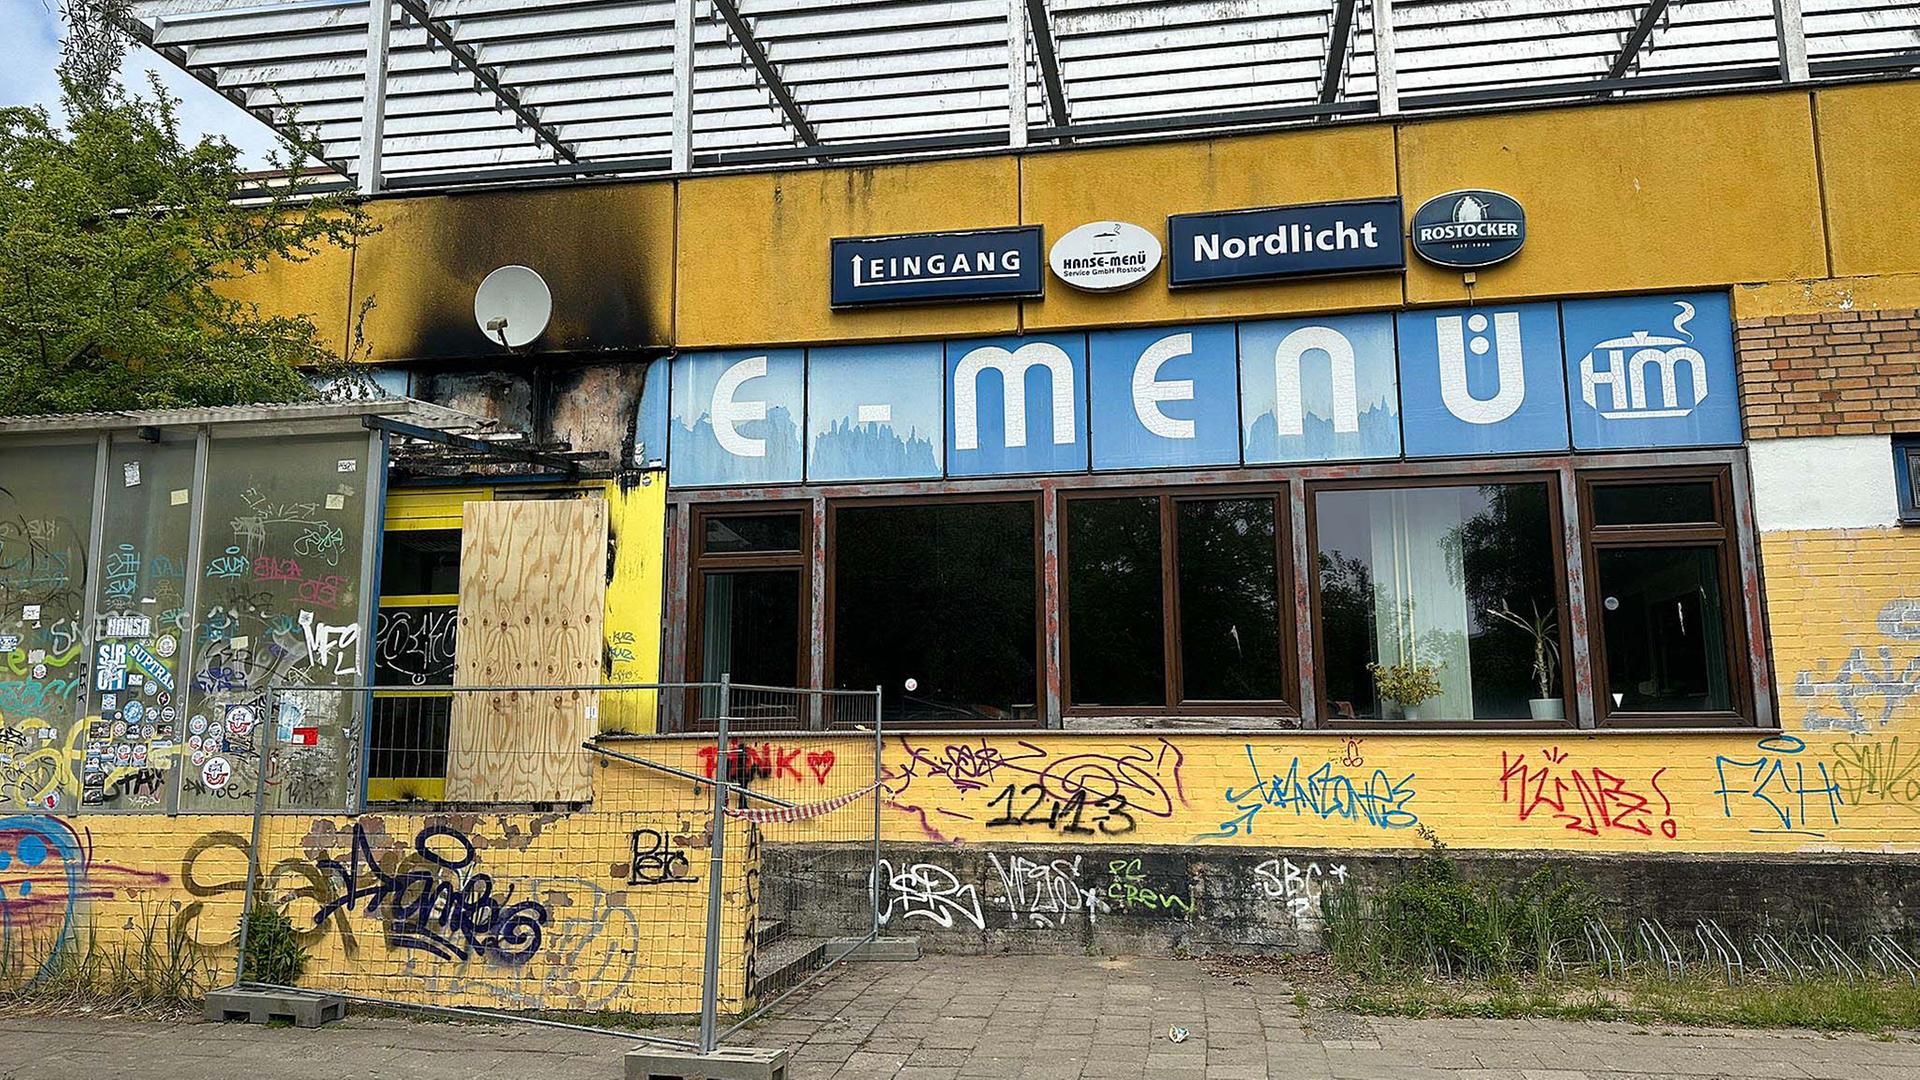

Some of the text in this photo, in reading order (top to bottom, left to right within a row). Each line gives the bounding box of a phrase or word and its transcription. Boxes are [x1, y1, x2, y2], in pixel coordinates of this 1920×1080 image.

[1193, 219, 1378, 262] Nordlicht
[1420, 222, 1519, 241] ROSTOCKER
[870, 250, 1020, 278] EINGANG
[1063, 269, 1090, 277] Service
[1116, 266, 1147, 274] Rostock
[107, 616, 151, 637] HANSA
